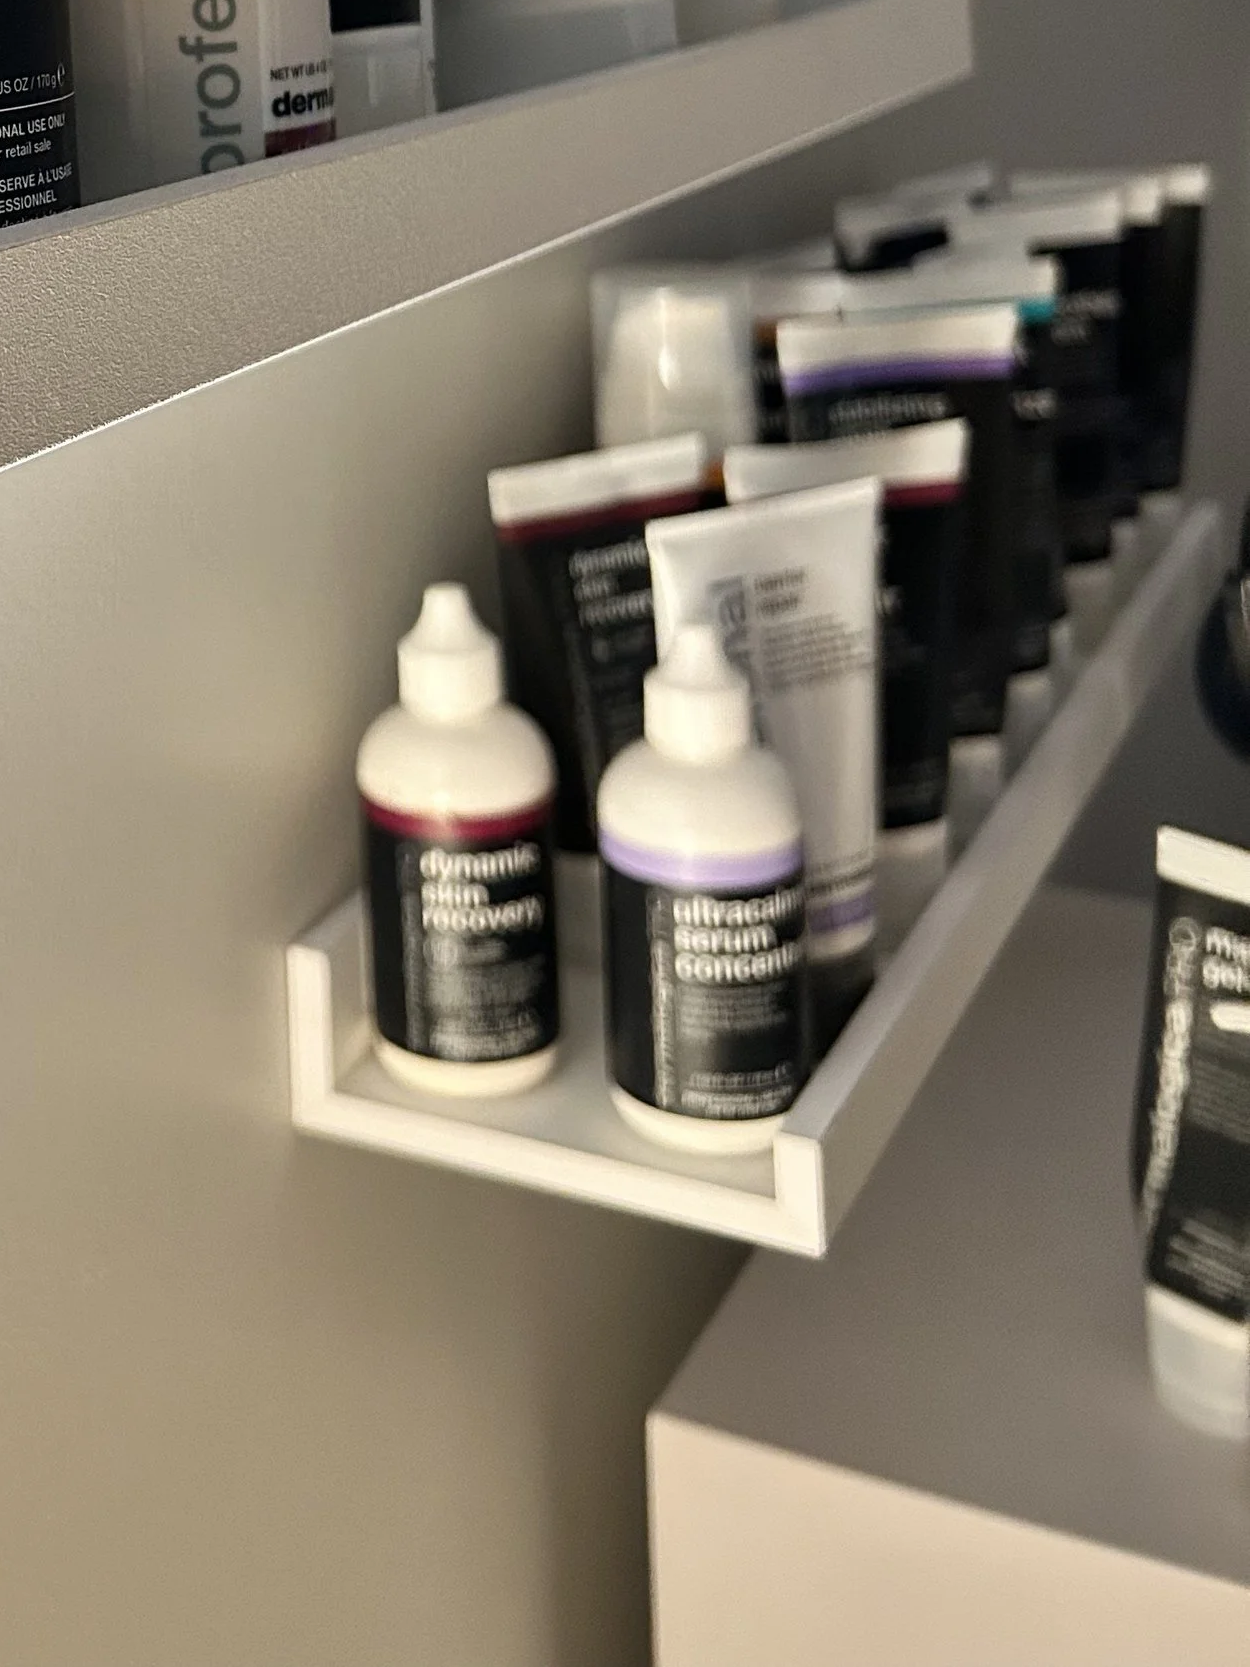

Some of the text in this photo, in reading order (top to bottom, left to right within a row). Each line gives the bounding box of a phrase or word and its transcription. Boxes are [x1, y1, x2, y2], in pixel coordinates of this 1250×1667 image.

[270, 66, 289, 82] NET
[13, 76, 29, 93] OZ
[27, 116, 47, 135] USE
[5, 140, 33, 159] retail
[33, 138, 52, 154] sale
